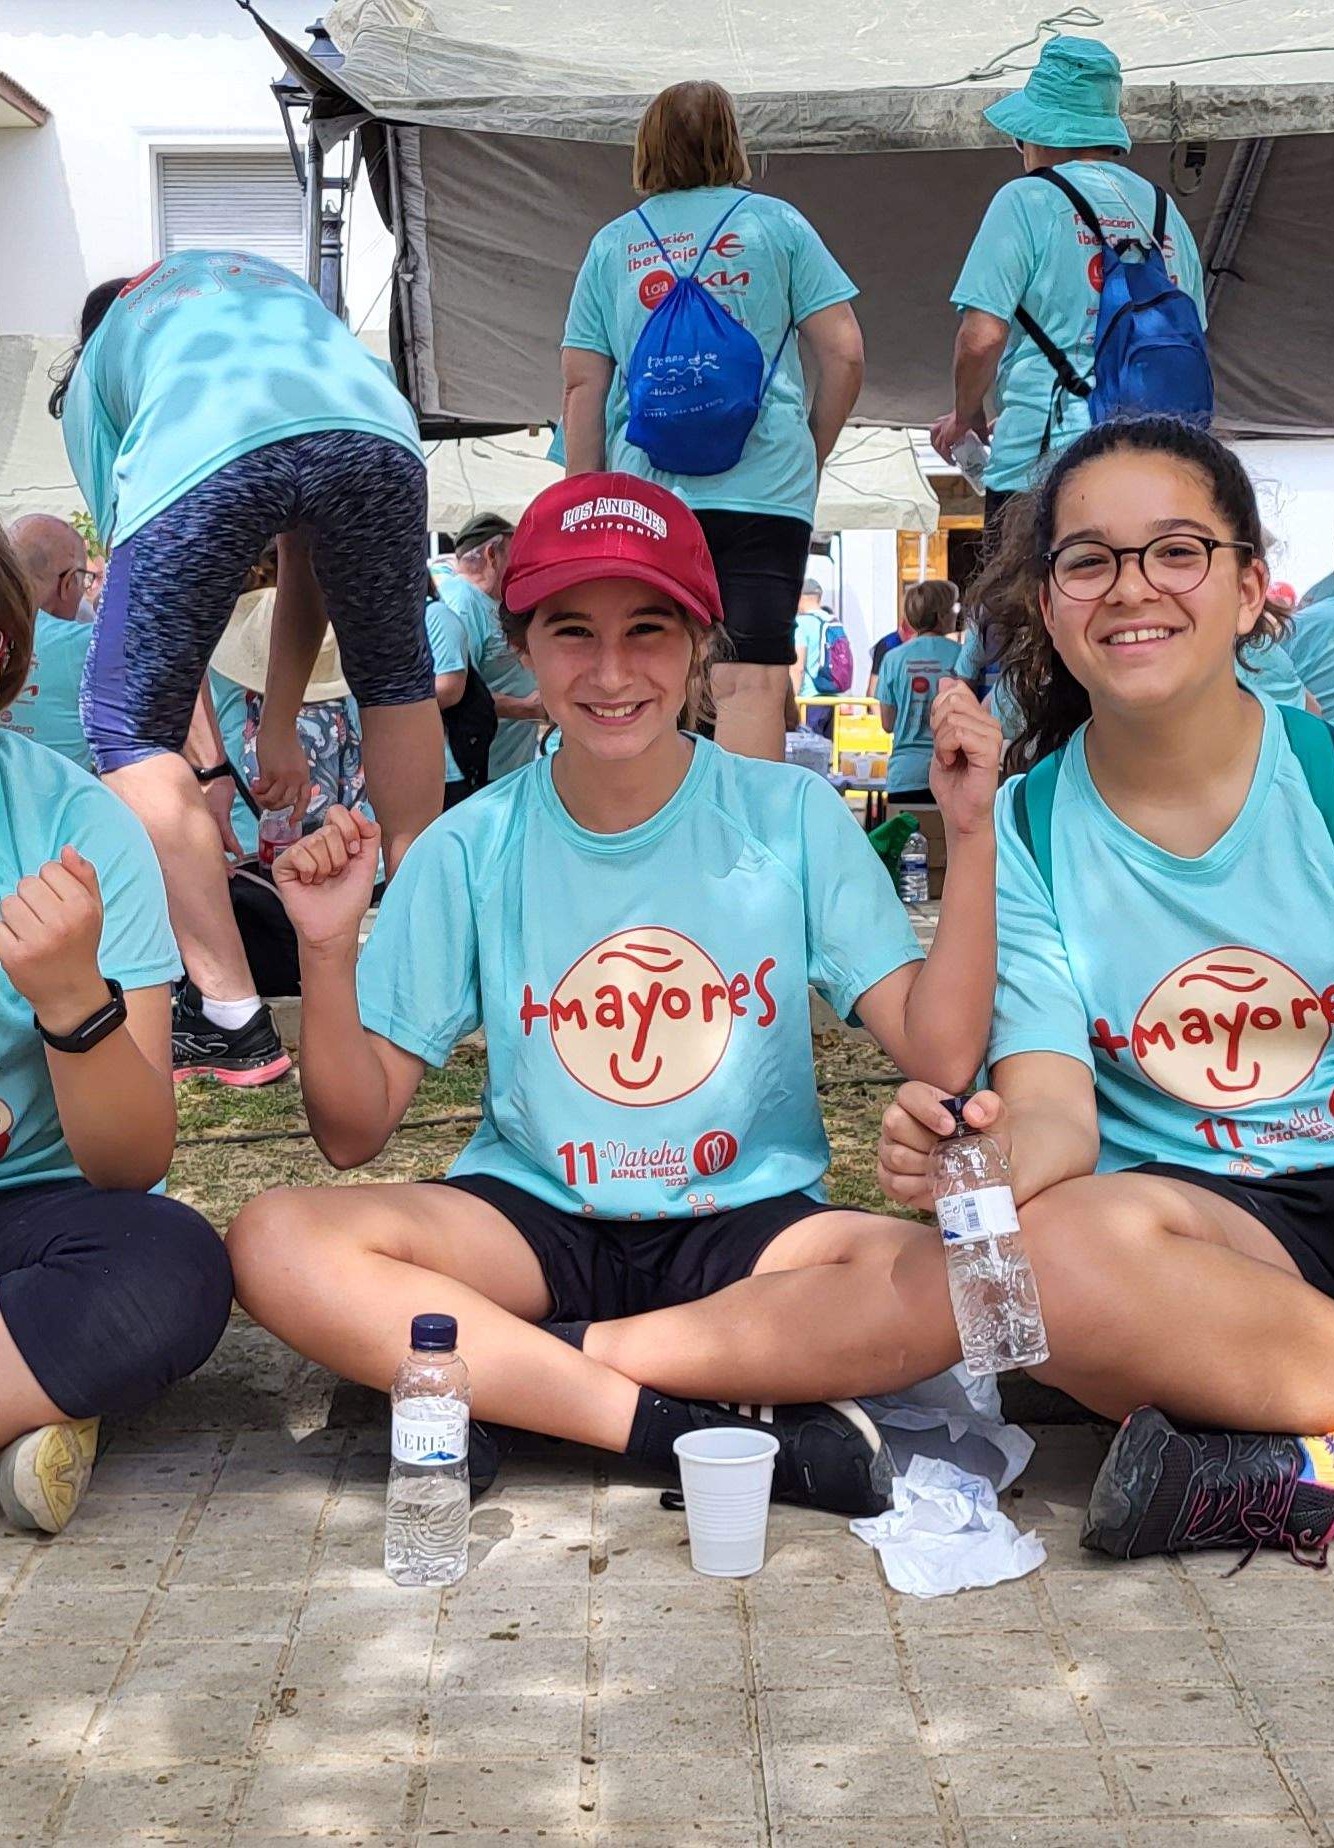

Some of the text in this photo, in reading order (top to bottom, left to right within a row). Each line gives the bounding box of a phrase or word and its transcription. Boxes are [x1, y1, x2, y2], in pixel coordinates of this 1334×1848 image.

[628, 247, 698, 272] iberaja
[561, 497, 667, 539] LOS ANGELES
[570, 522, 660, 541] CALIFORNIA
[520, 957, 776, 1062] +mayores
[607, 1140, 687, 1167] Marcha
[611, 1165, 687, 1179] ASPACE HUESCA
[665, 1177, 689, 1187] 2023
